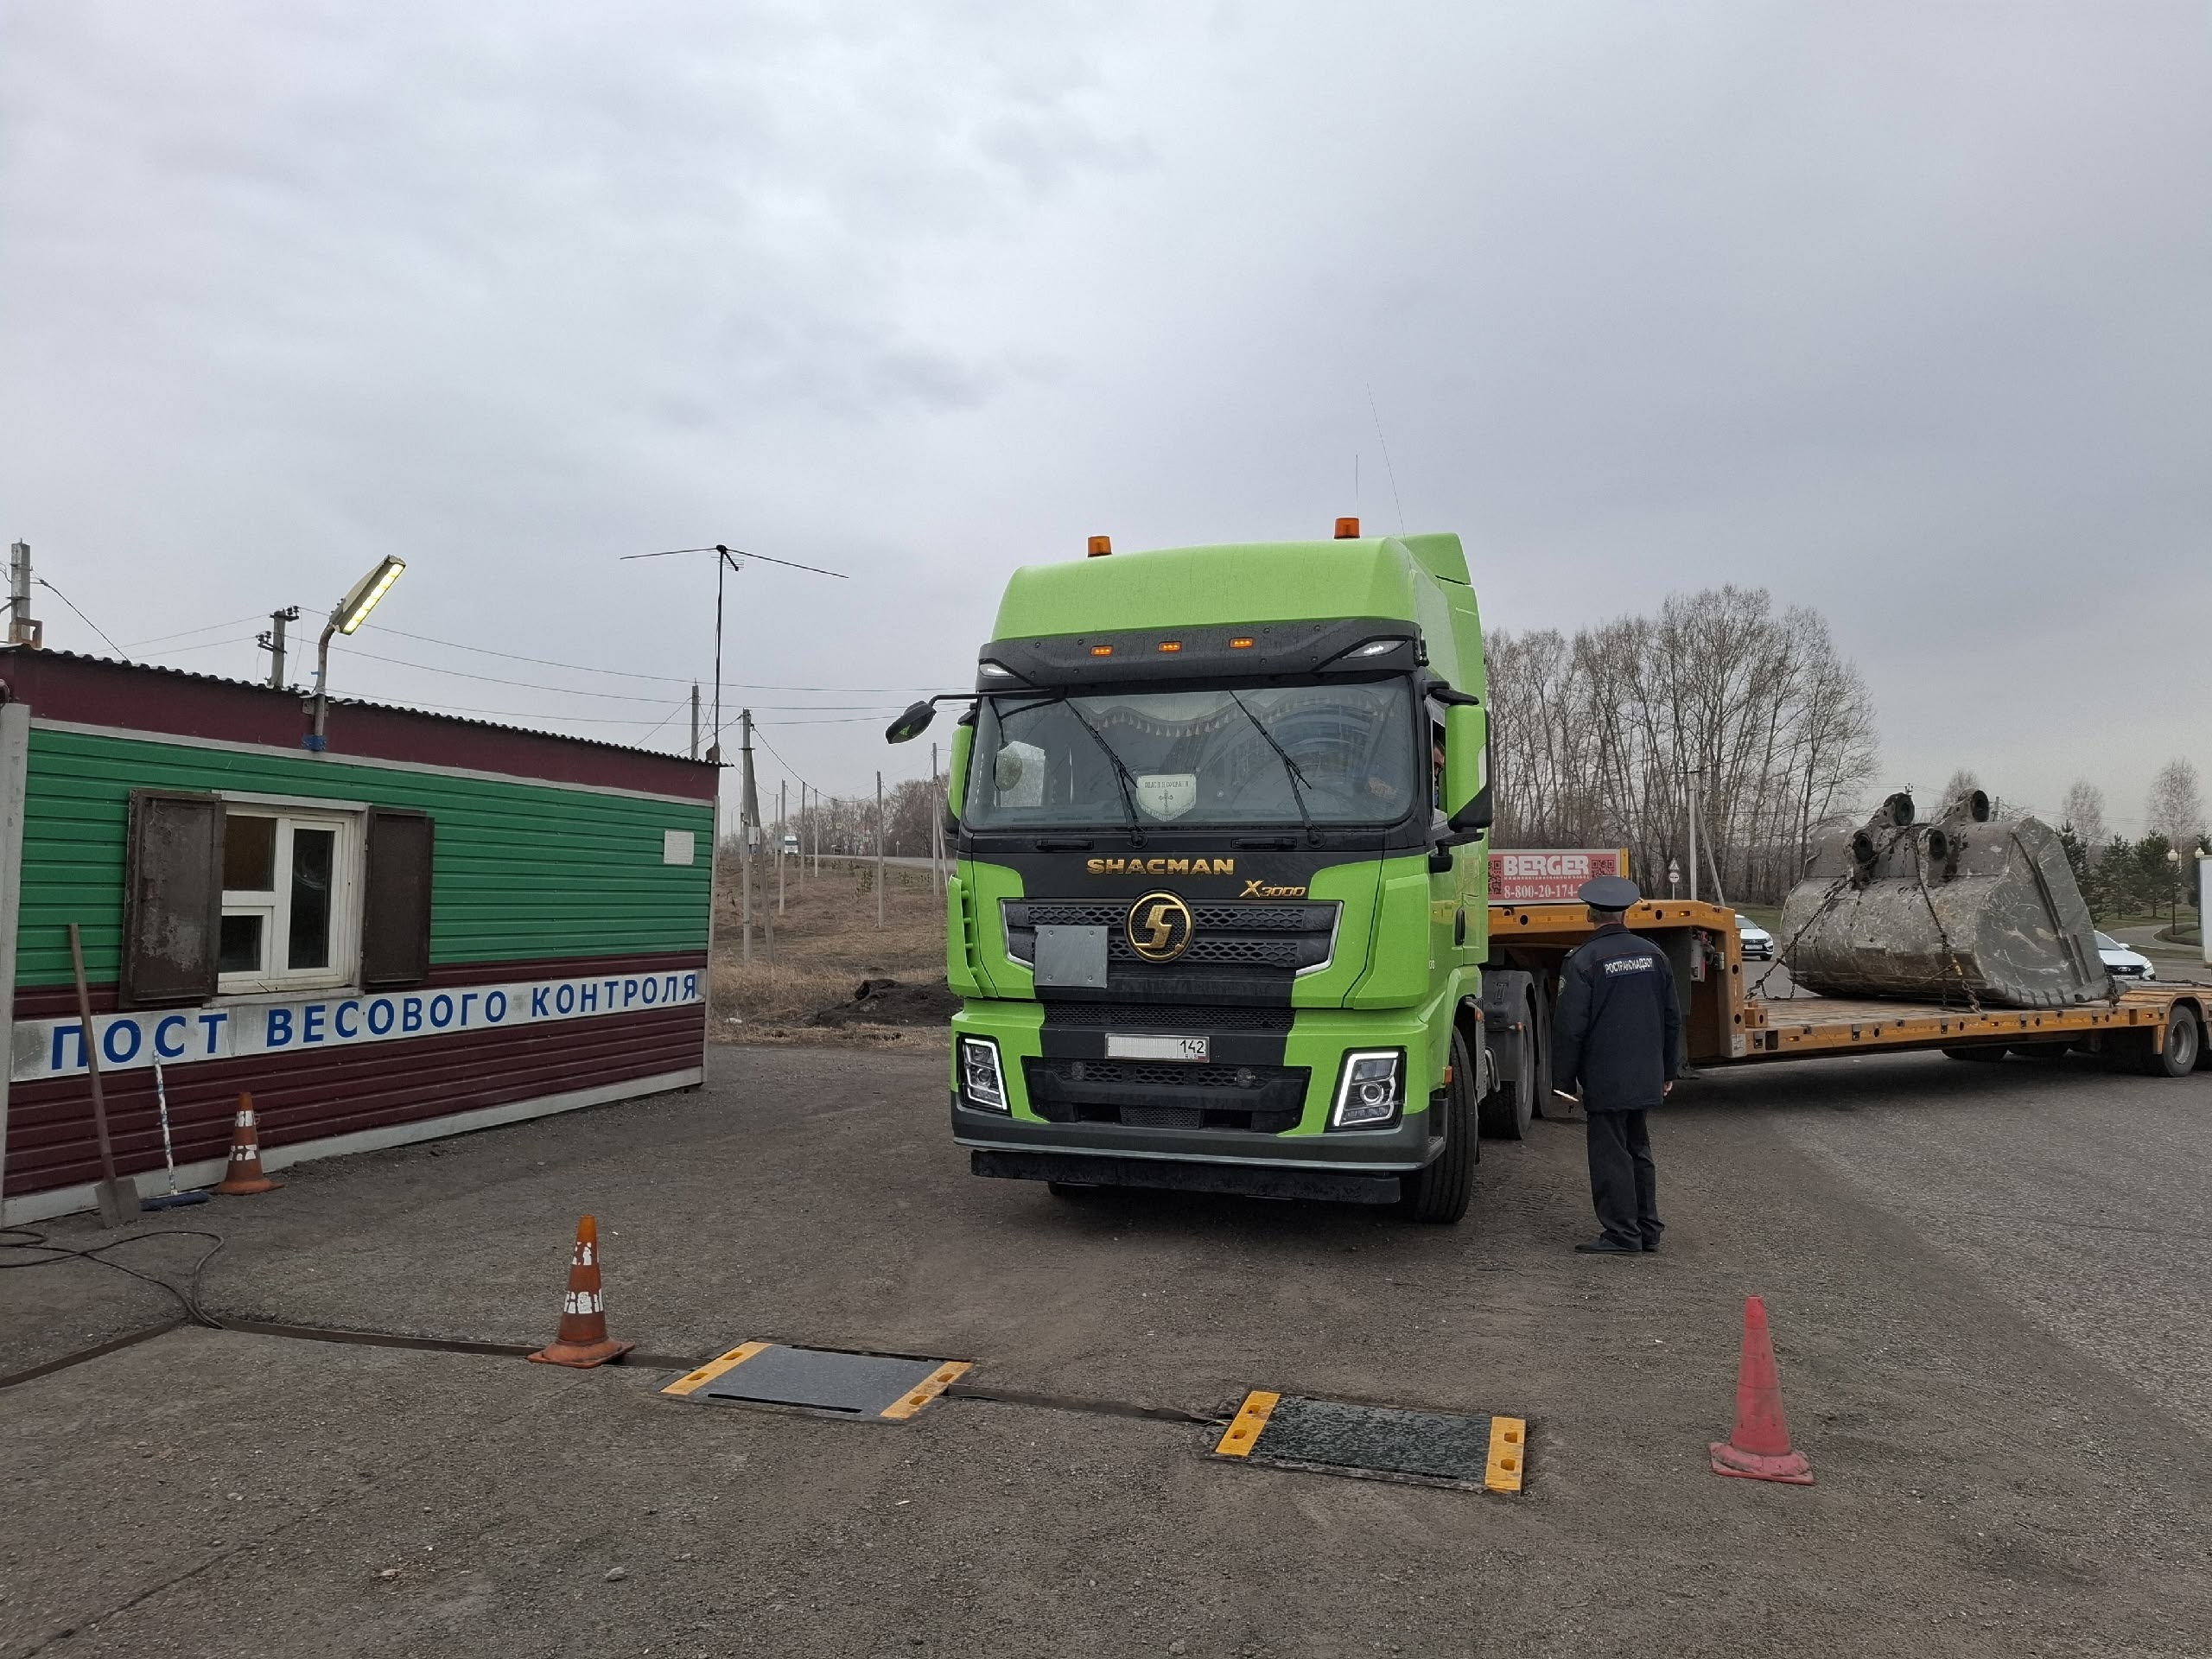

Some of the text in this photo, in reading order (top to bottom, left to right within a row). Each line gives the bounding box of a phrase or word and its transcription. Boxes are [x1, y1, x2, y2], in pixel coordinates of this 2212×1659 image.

[1086, 859, 1235, 874] SHACMAN
[1503, 855, 1589, 876] BERGER
[1238, 880, 1306, 898] X3000
[1503, 883, 1583, 899] 8-800-20-174-
[51, 974, 696, 1070] ПОСТ ВЕСОВОГО КОНТРОЛЯ
[1179, 1039, 1205, 1054] 142
